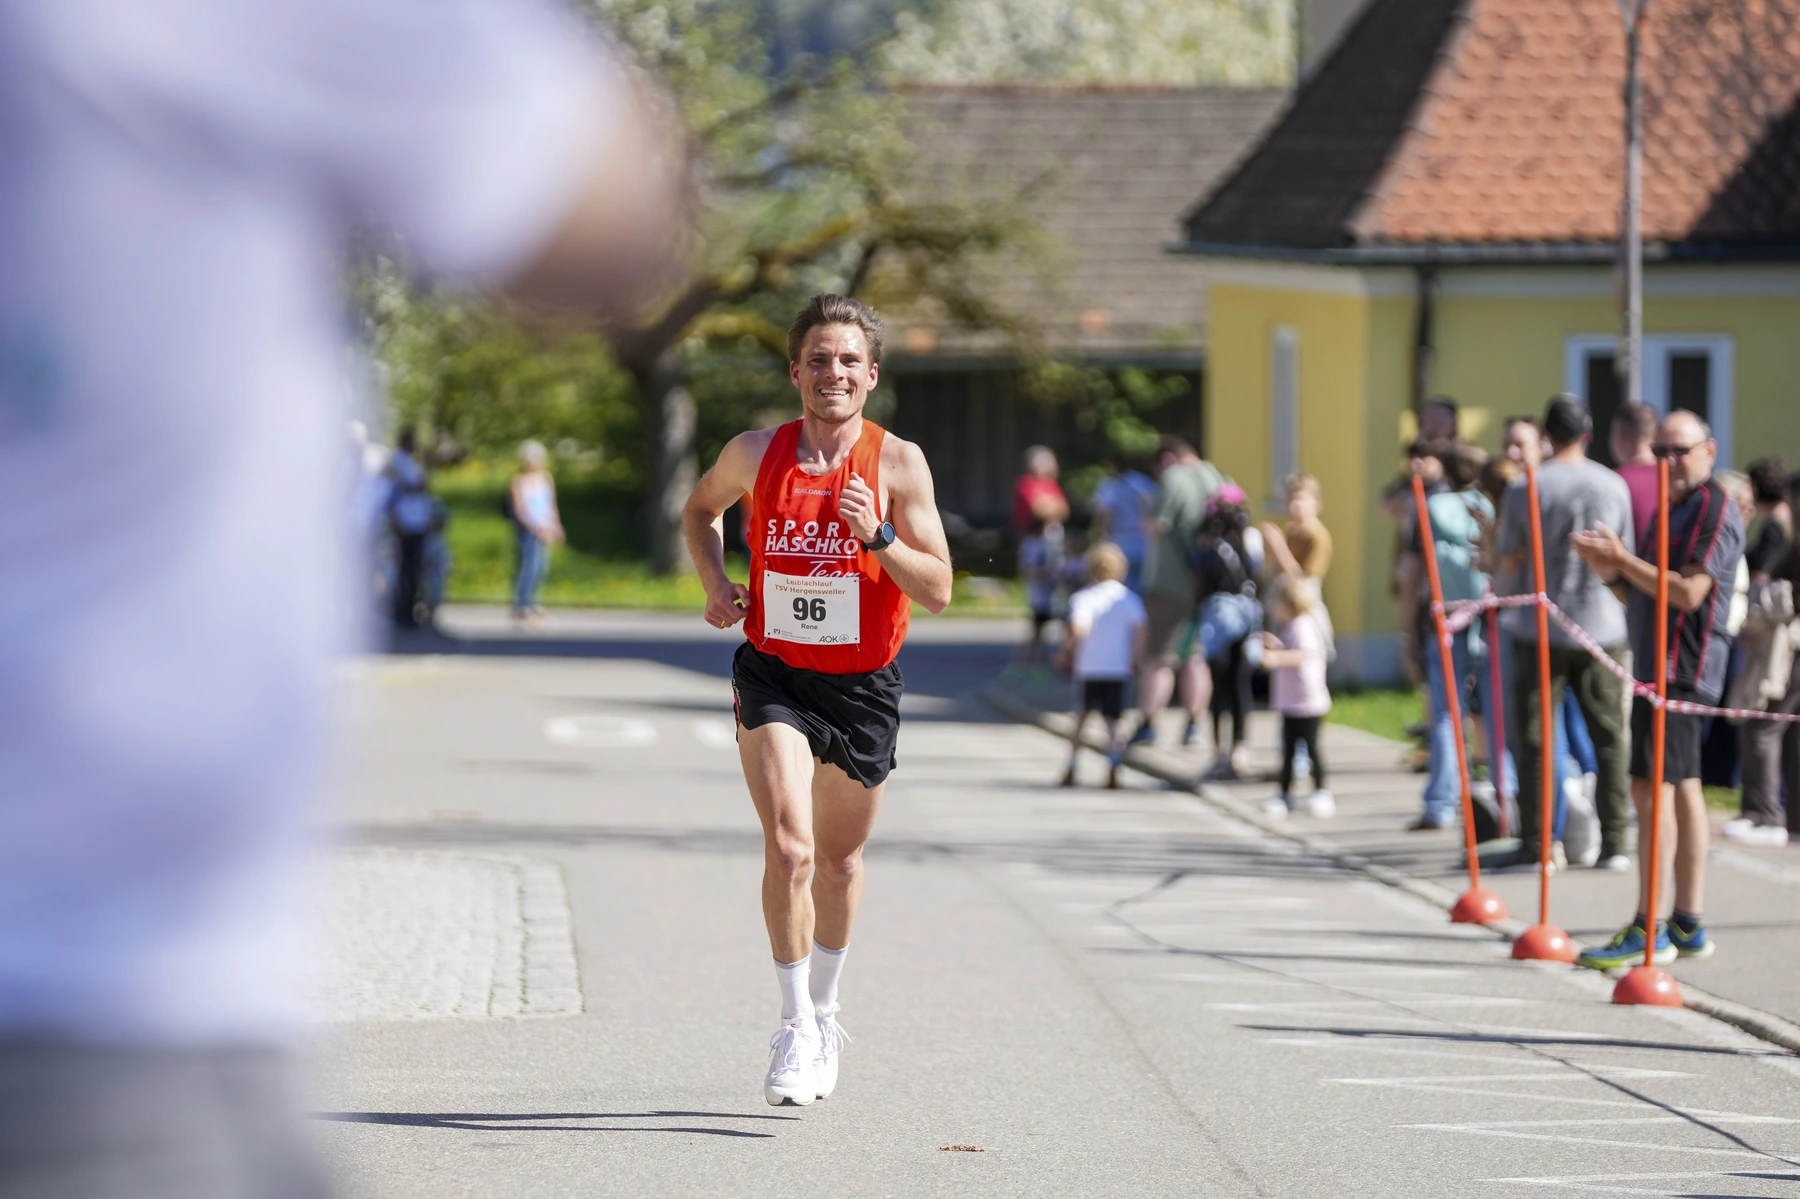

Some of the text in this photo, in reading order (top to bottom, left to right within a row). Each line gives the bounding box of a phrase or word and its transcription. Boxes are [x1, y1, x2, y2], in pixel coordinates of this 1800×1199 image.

[795, 488, 832, 496] SALOMON
[766, 536, 858, 554] HASCHKO
[787, 579, 833, 587] Leiblachlauf
[775, 584, 846, 595] TSV Hergensweiler
[793, 597, 827, 622] 96
[819, 635, 838, 643] AOK
